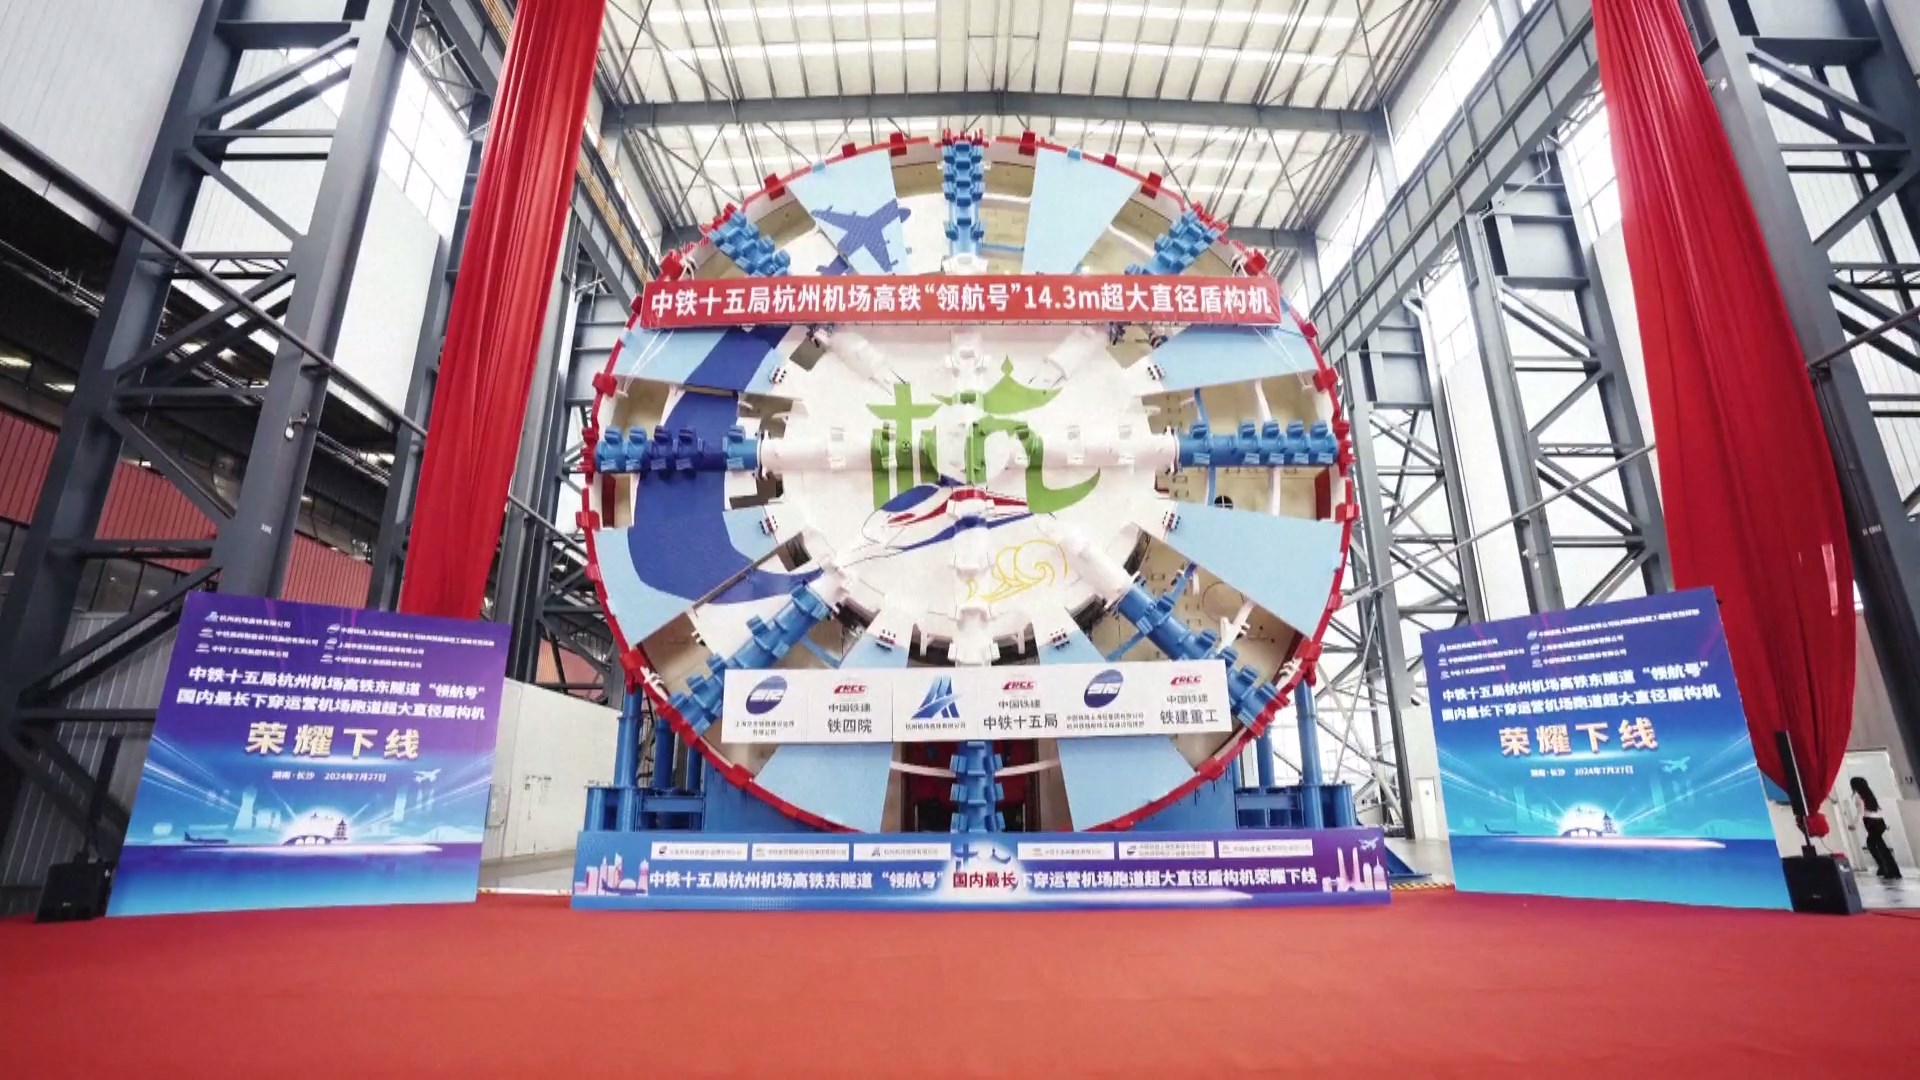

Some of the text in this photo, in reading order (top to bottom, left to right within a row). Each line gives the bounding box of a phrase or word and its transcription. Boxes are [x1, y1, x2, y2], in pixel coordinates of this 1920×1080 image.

[650, 282, 1273, 317] 中铁十五局杭州机场高铁“领航号”14.3m超大直径盾构机
[176, 687, 485, 720] 国内最长下穿运营机场跑道超大直径盾构机
[827, 718, 873, 734] 铁四院
[983, 713, 1058, 731] 中铁十五局
[1159, 709, 1220, 725] 铁建重工
[245, 720, 420, 759] 荣耀下线
[1498, 716, 1659, 757] 荣耀下线
[324, 772, 387, 783] 2024年7月27日
